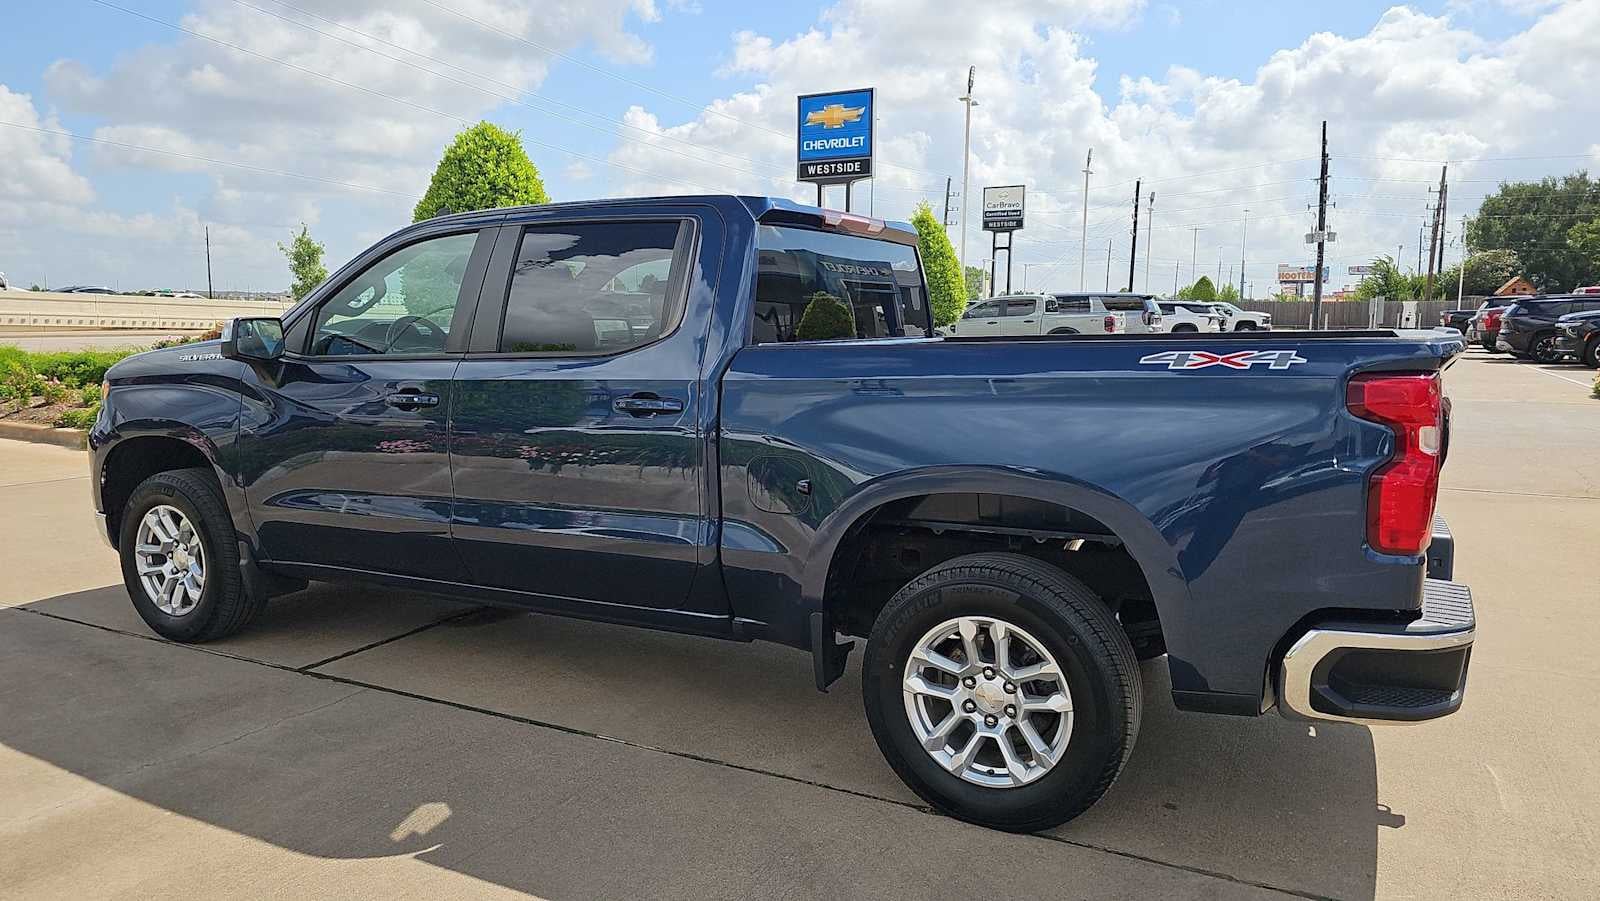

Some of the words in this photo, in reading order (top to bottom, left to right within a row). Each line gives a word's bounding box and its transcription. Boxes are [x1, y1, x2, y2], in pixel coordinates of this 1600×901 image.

[803, 136, 865, 151] CHEVROLET
[808, 161, 861, 175] WESTSIDE
[986, 201, 1021, 209] CarBravo
